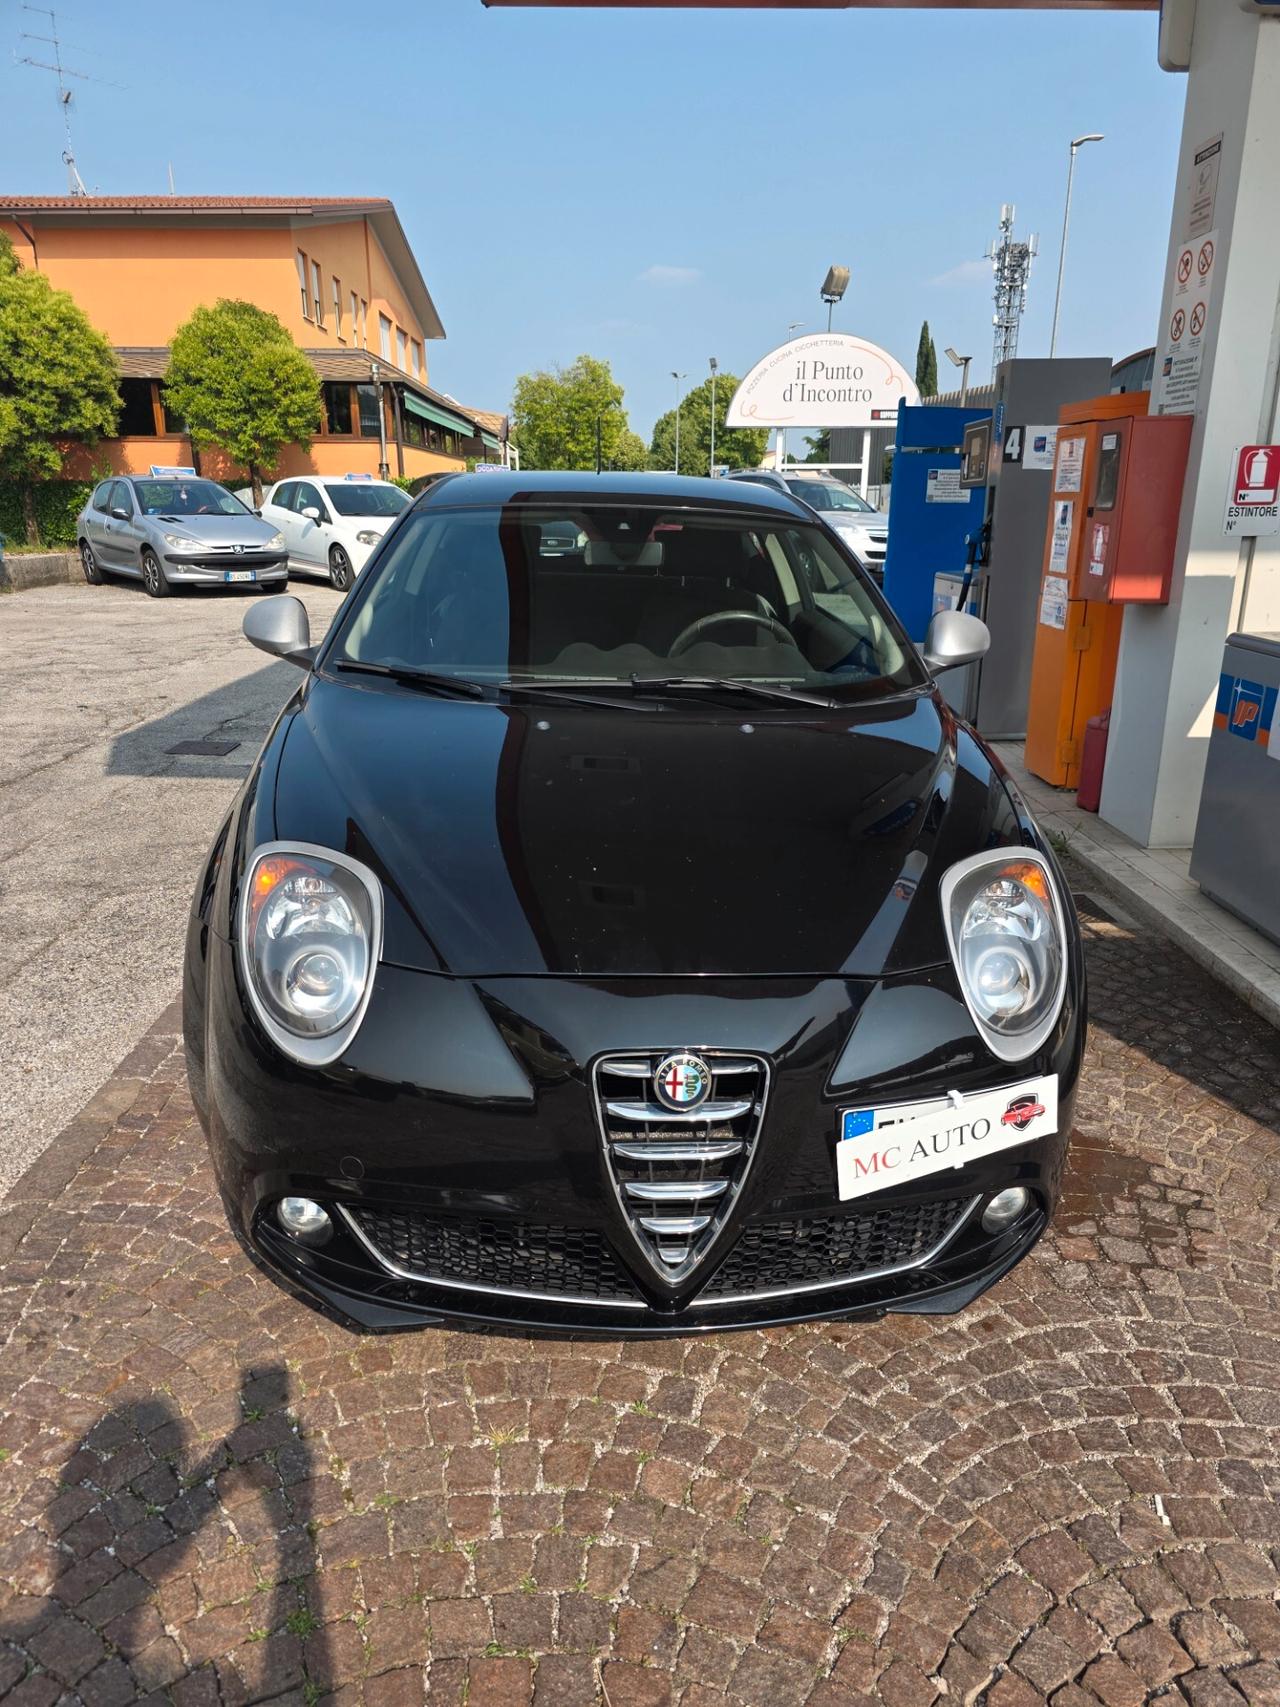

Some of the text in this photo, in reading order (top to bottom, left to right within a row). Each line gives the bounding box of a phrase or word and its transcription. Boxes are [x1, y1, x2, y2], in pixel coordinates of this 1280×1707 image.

[796, 360, 864, 380] il Punto
[782, 383, 873, 402] d'Incontro
[1005, 428, 1021, 460] 4
[1227, 506, 1278, 517] ESTINTORE
[853, 1118, 991, 1179] MC AUTO
